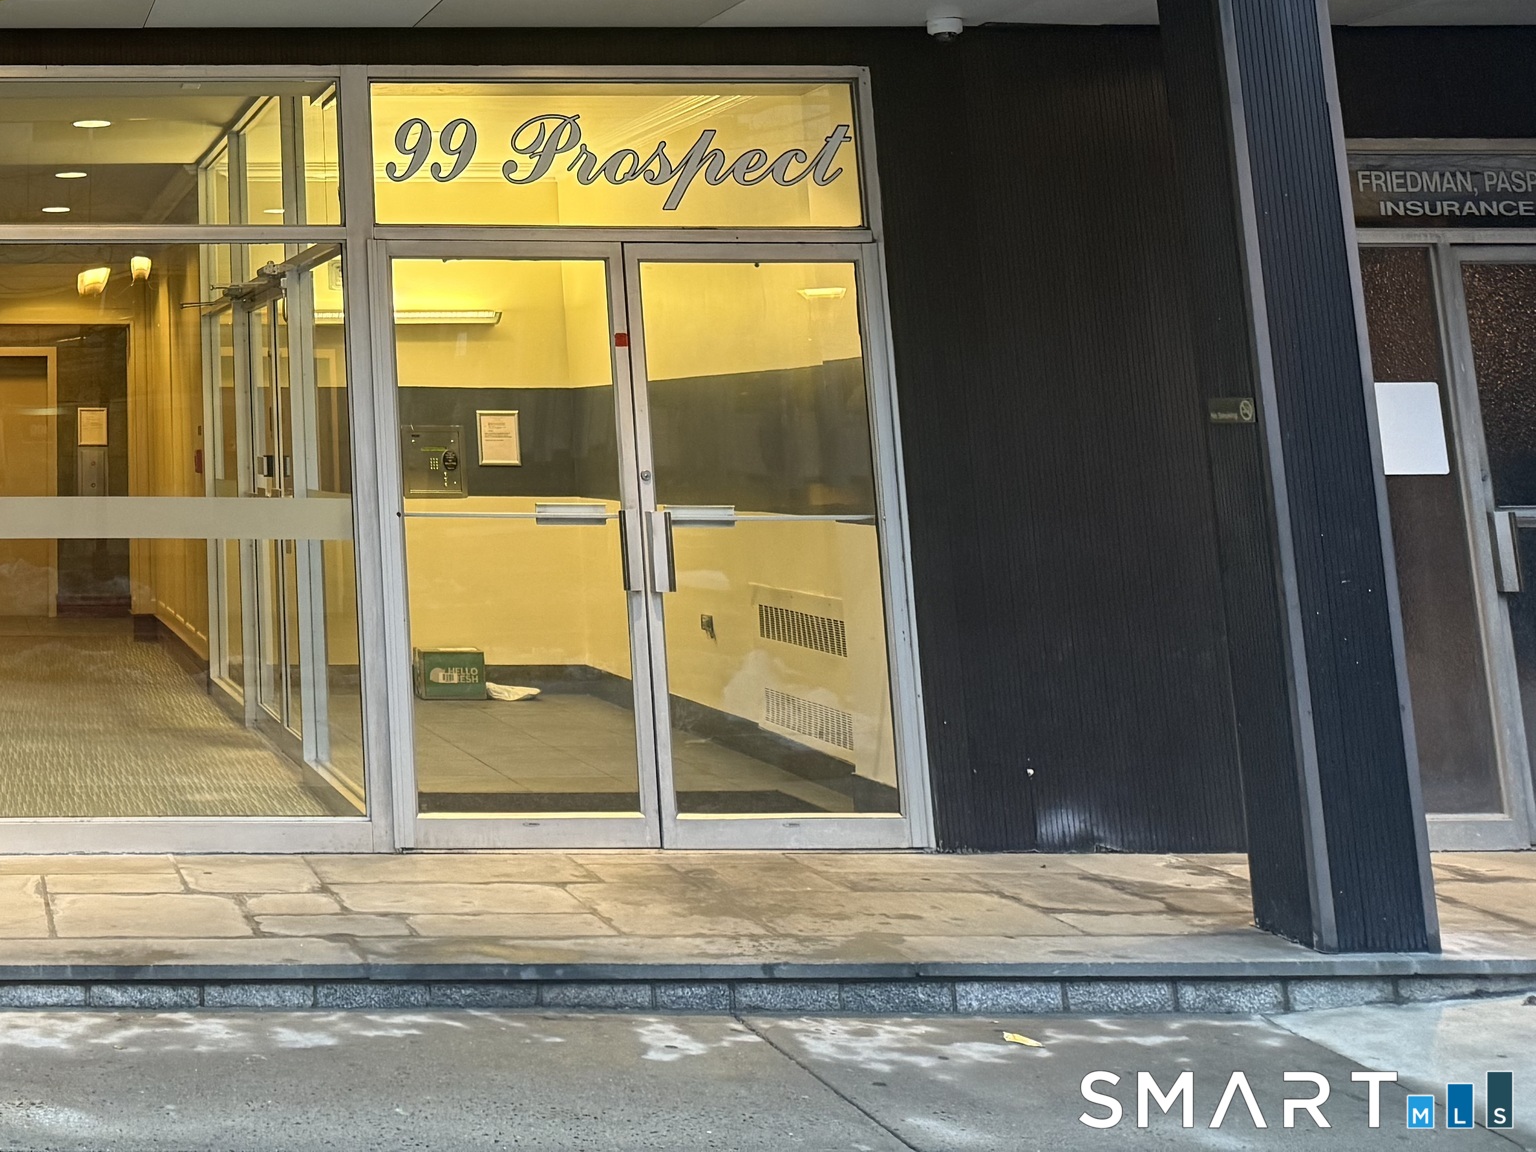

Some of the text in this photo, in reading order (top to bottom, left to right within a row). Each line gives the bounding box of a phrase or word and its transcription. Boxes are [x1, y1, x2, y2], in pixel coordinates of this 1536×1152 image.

[385, 113, 854, 211] 99 Prospect
[1356, 170, 1479, 197] FRIEDMAN,
[1379, 200, 1536, 217] INSURANCE
